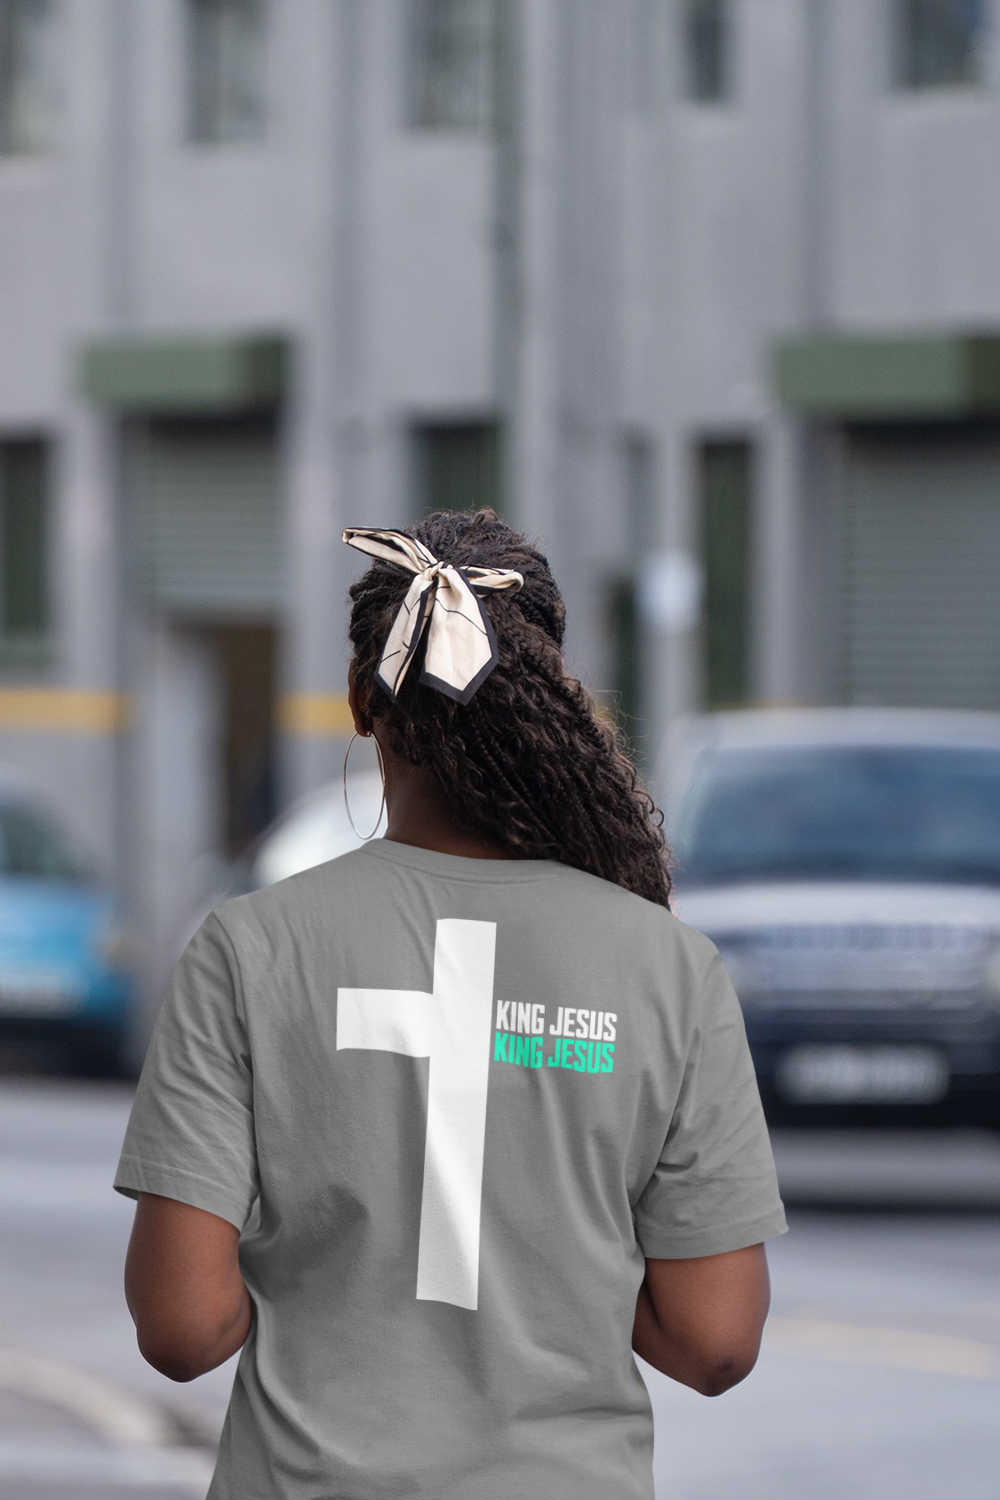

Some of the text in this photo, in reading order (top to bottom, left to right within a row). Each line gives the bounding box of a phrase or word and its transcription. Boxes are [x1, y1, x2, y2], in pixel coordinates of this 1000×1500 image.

[496, 1000, 617, 1042] KING JESUS
[494, 1031, 615, 1074] KING JESUS
